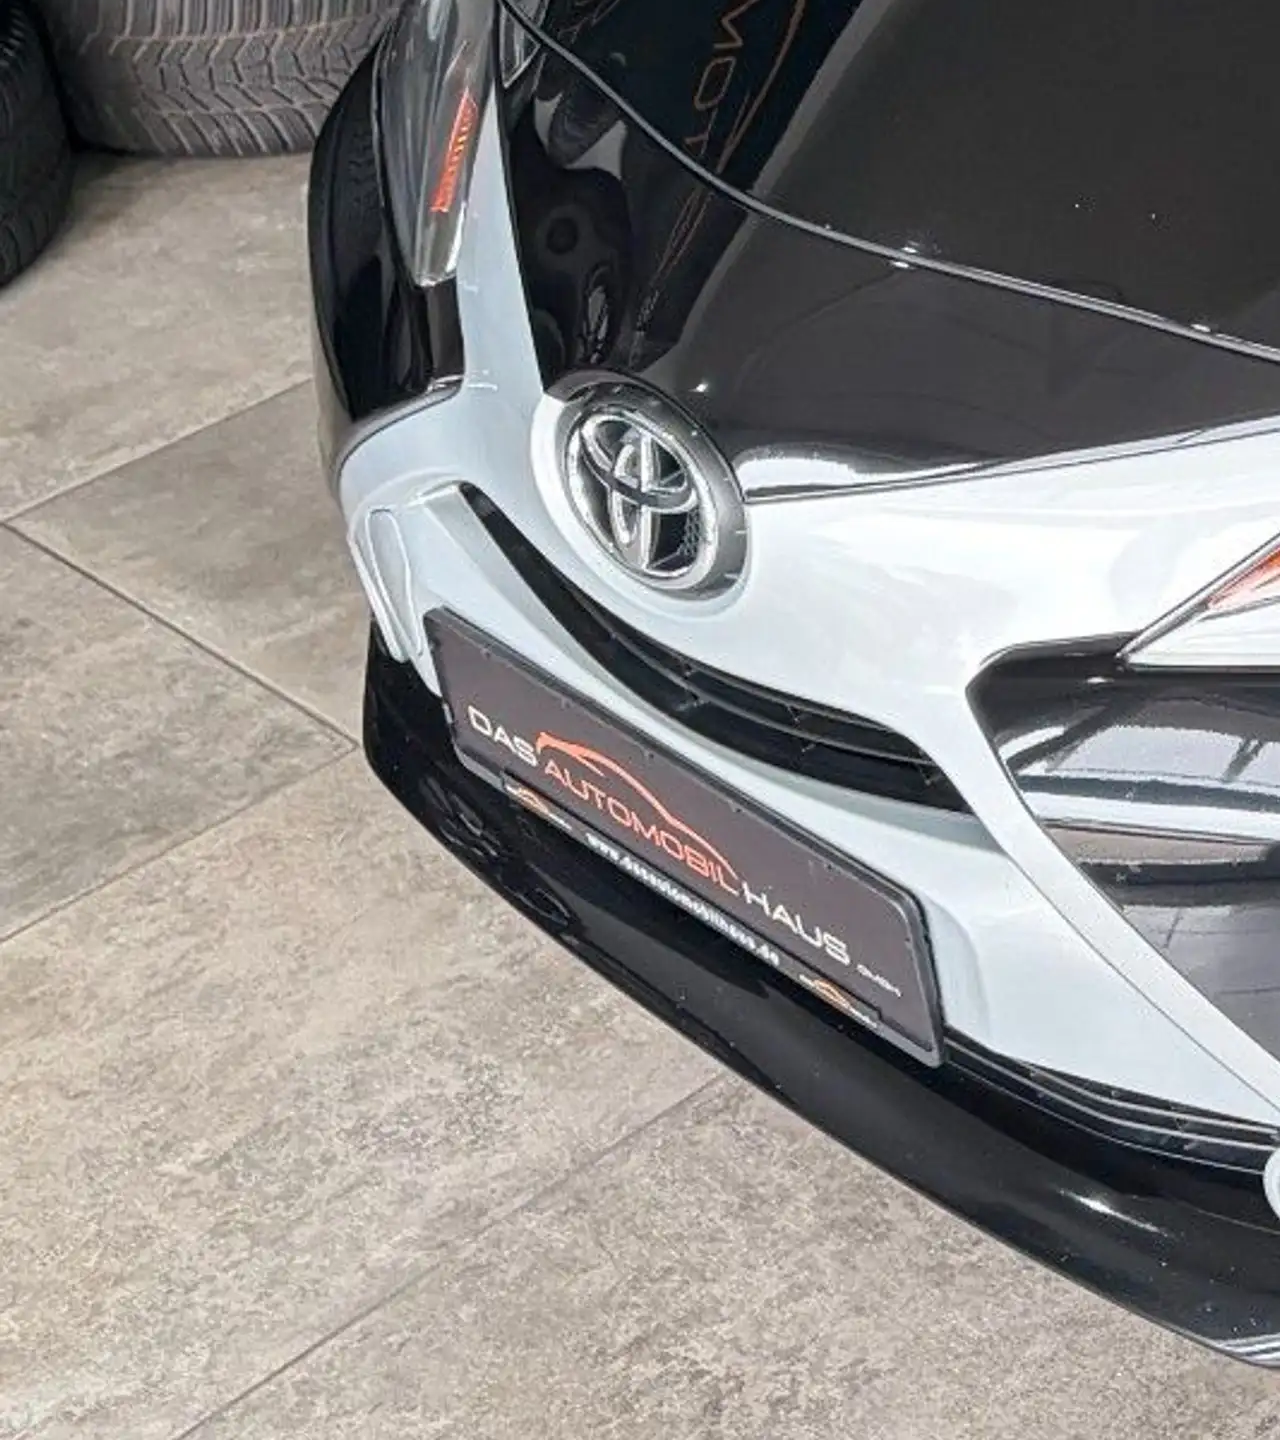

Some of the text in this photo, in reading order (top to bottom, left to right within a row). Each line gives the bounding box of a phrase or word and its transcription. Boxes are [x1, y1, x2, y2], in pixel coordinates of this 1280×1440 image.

[467, 704, 537, 767] DAS
[544, 758, 740, 899] AUTOMOBIL
[740, 880, 851, 967] HAUS
